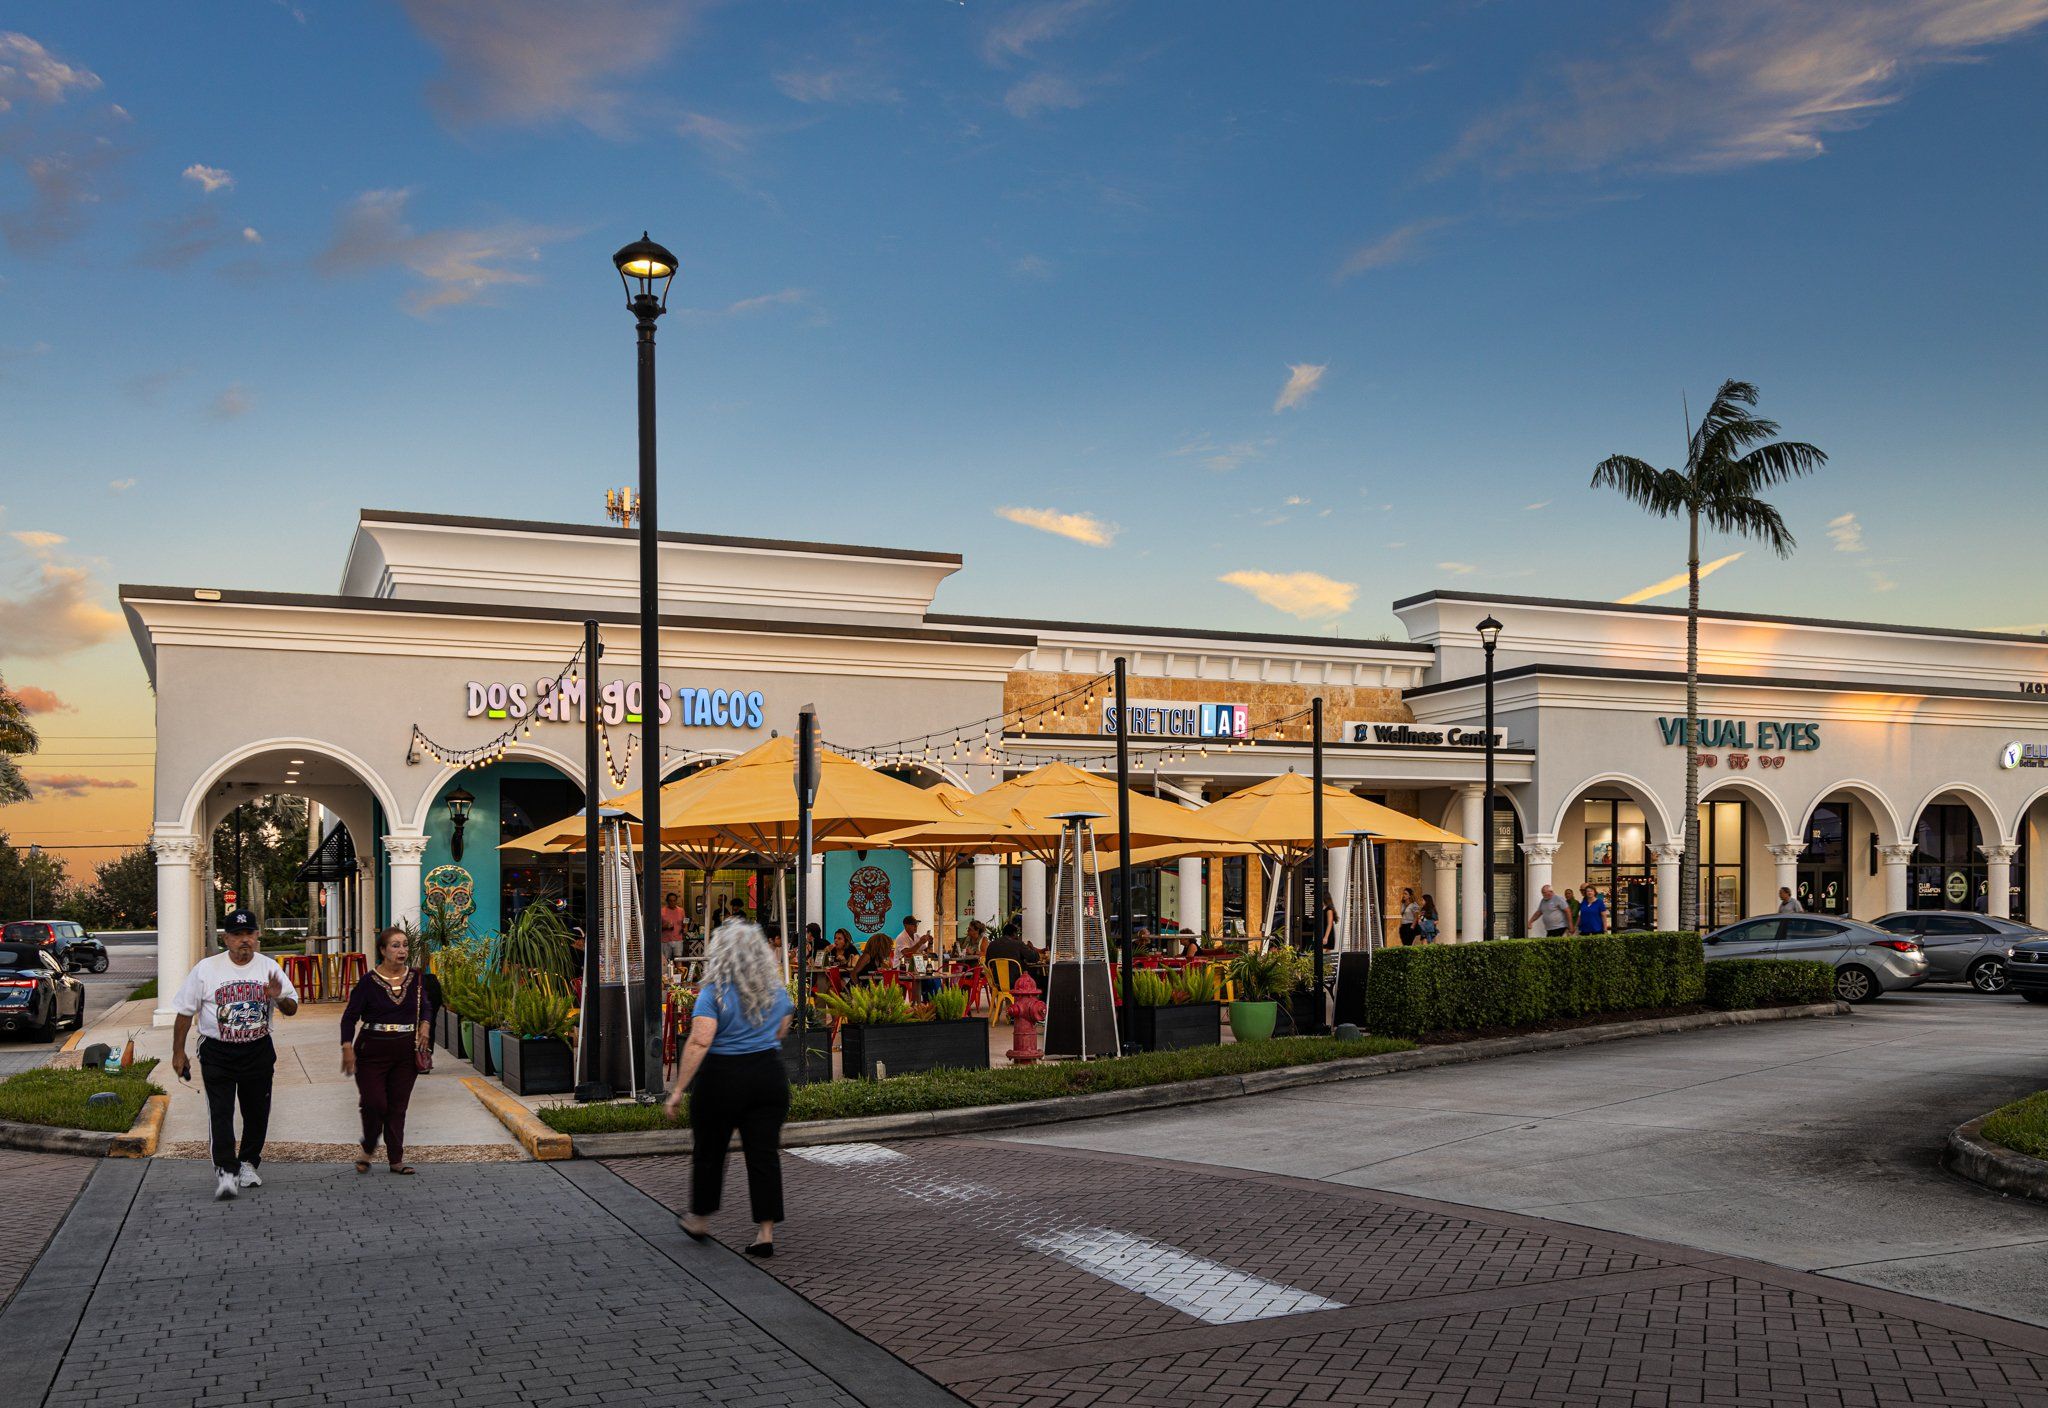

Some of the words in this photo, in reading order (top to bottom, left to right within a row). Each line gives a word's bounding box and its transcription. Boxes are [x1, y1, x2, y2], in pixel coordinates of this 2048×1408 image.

[466, 680, 528, 719] DOS
[679, 687, 765, 729] TACOS
[1203, 709, 1246, 735] LAB
[1373, 725, 1443, 745] Wellness
[1658, 716, 1754, 749] VIUAL
[1757, 721, 1821, 751] EYES
